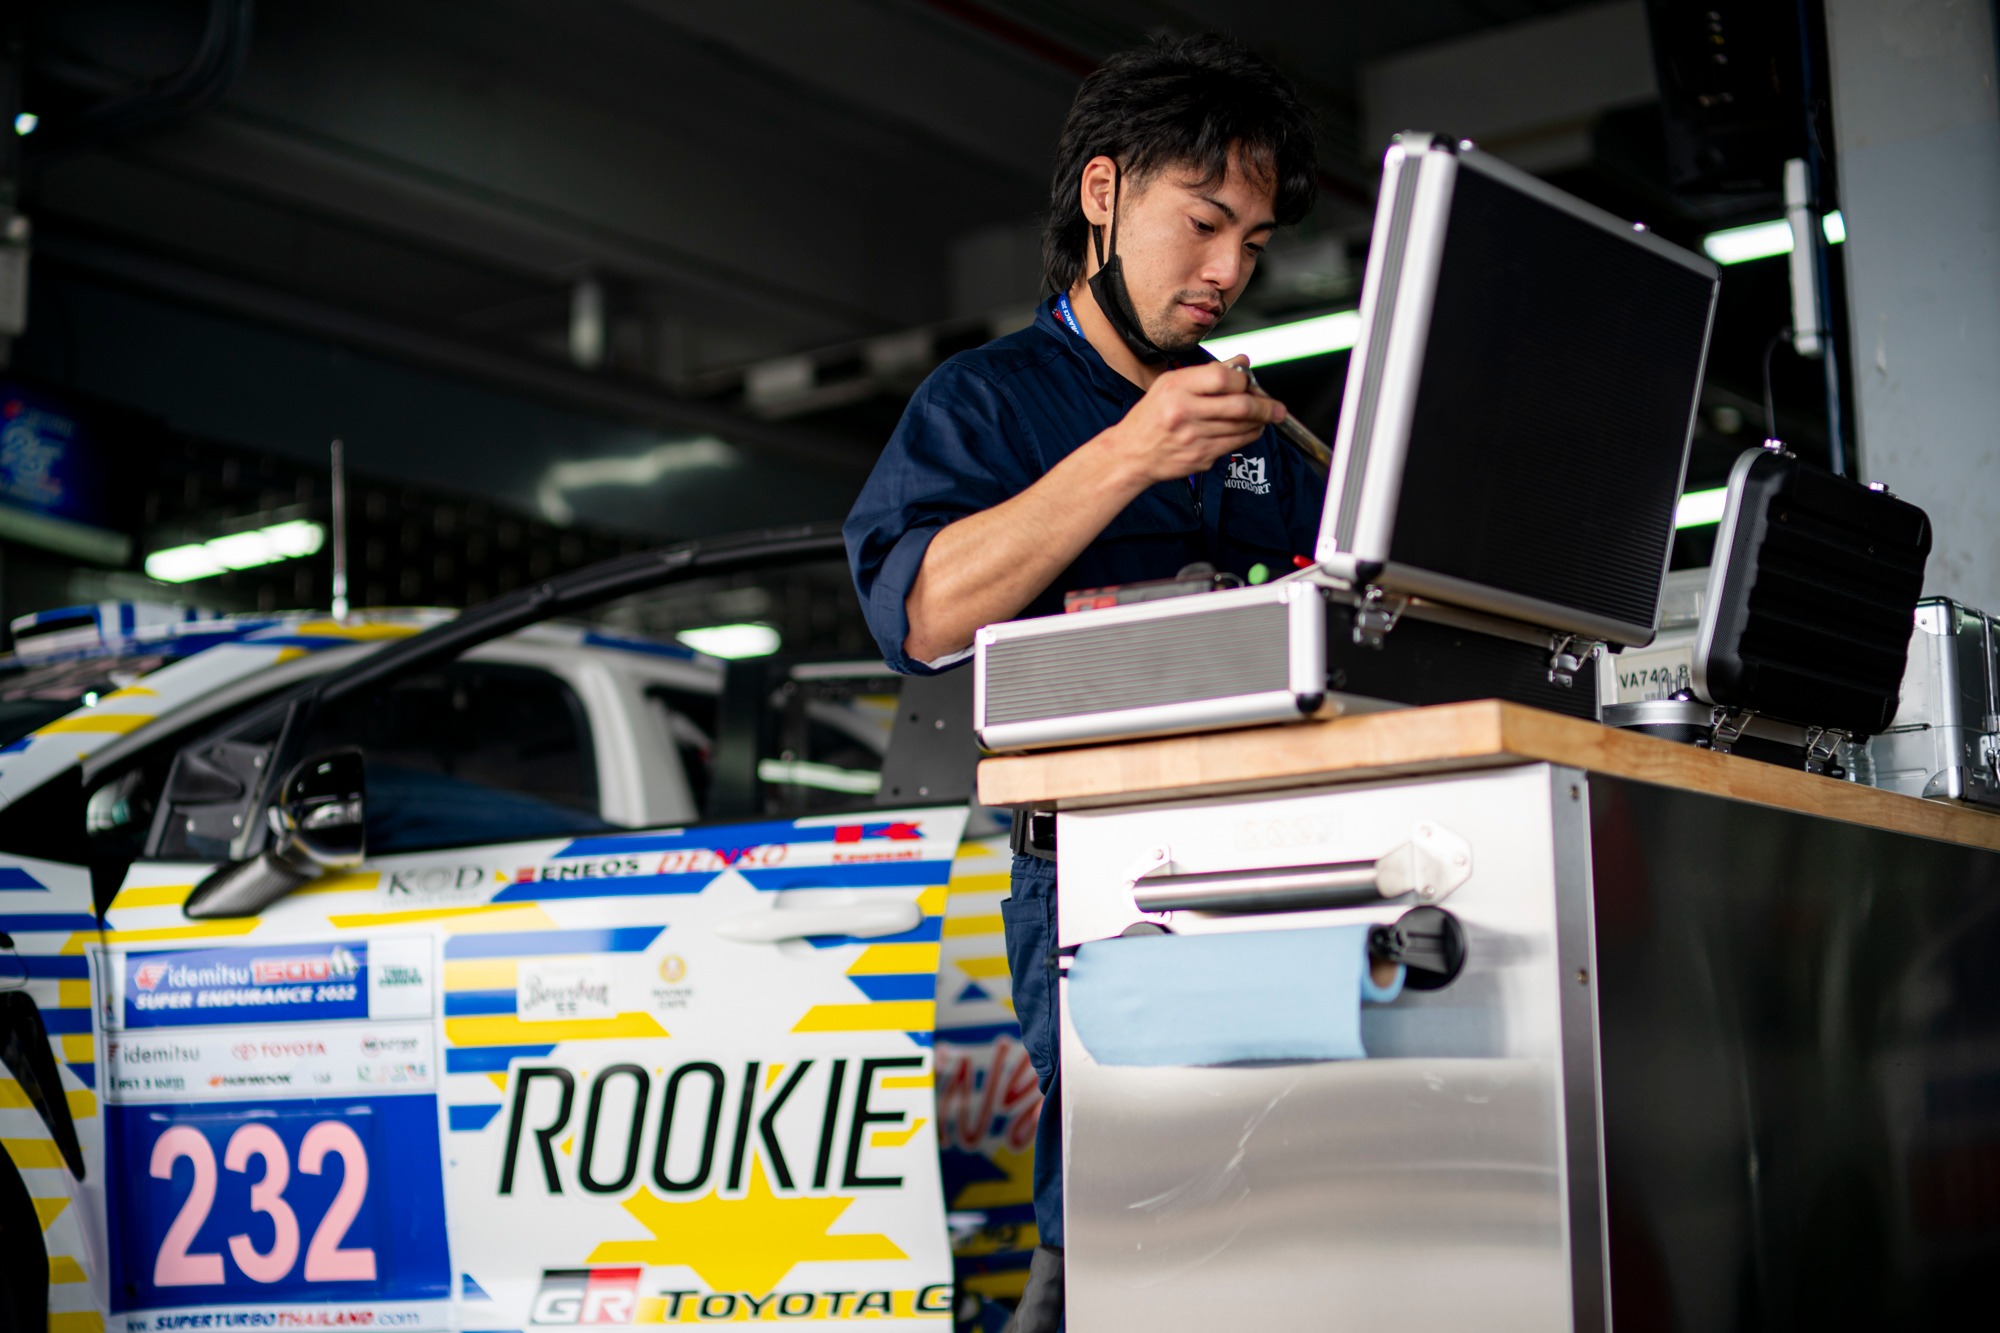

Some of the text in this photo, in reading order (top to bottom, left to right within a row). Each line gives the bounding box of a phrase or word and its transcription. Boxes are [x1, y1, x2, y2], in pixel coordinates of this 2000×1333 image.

[1224, 478, 1271, 495] MOTORORT
[540, 858, 640, 884] ENEOS
[658, 844, 788, 874] DENSO
[167, 959, 330, 987] idemitsu 1500
[136, 984, 358, 1010] SUPER ENDURANCE 2022
[123, 1044, 200, 1064] idemitsu
[260, 1042, 327, 1057] TOYOTA
[497, 1056, 925, 1197] ROOKIE
[149, 1120, 378, 1288] 232
[531, 1283, 636, 1325] GR
[660, 1290, 894, 1319] TOYOTA
